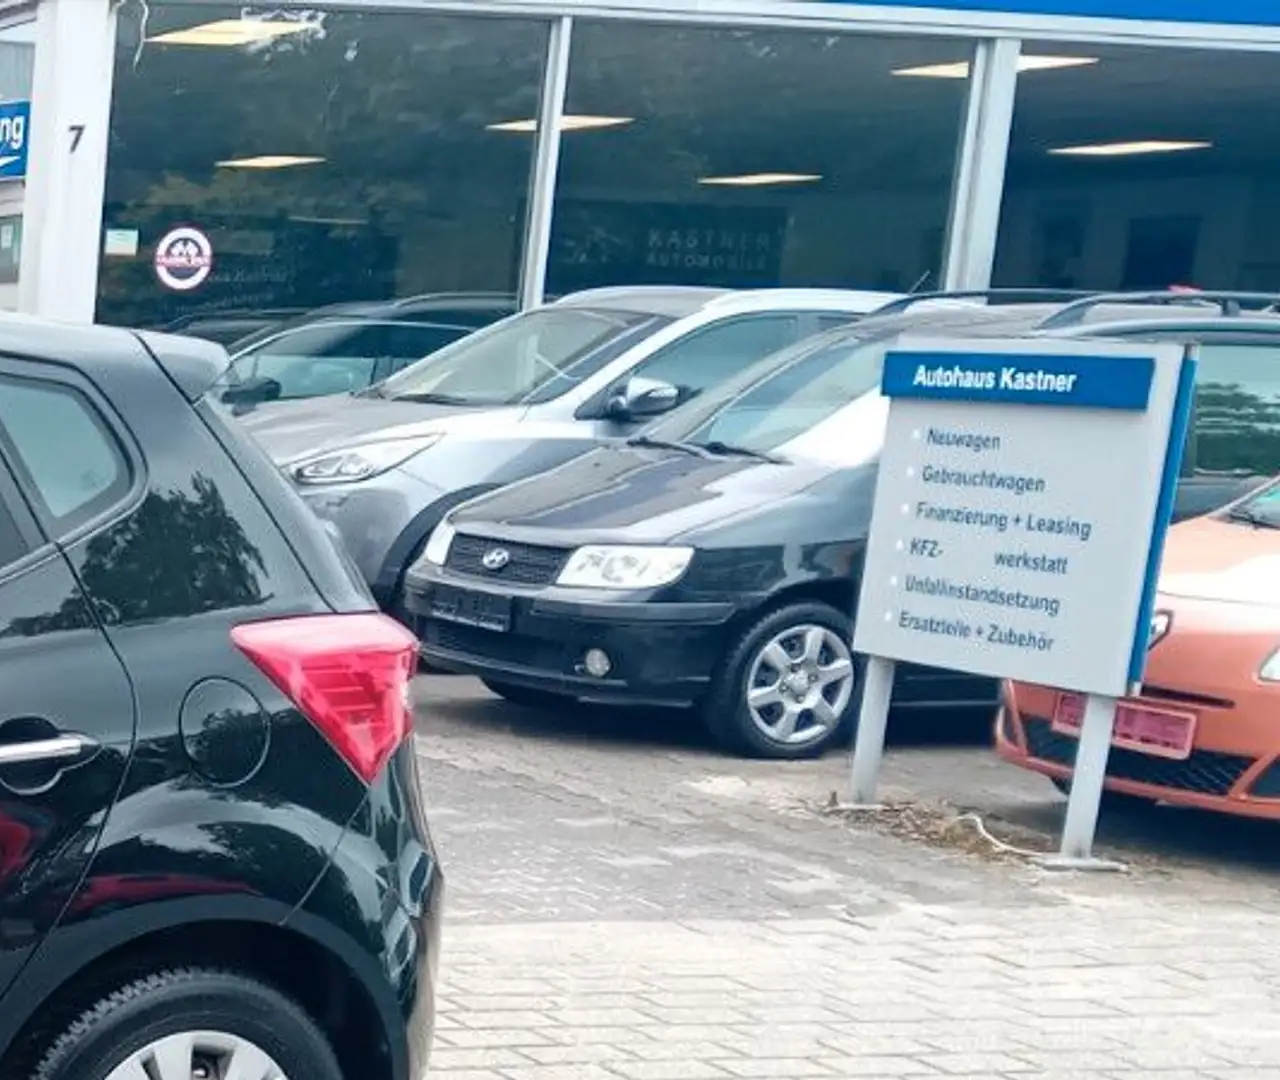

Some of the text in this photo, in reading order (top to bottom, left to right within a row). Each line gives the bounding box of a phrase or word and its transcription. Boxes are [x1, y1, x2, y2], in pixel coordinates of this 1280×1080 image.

[68, 126, 86, 153] 7
[913, 364, 1077, 392] Autohaus Kastner
[927, 428, 1000, 452] Neuwagen
[922, 464, 1045, 495] Gebrauchtwagen
[915, 502, 1008, 532] Finanzierung
[1026, 513, 1092, 541] Leasing
[909, 537, 1068, 574] KFZ- werkstatt
[905, 575, 1060, 617] Unfallinstandsetzung
[898, 610, 971, 638] Ersatzteile
[987, 623, 1055, 651] Zubehör
